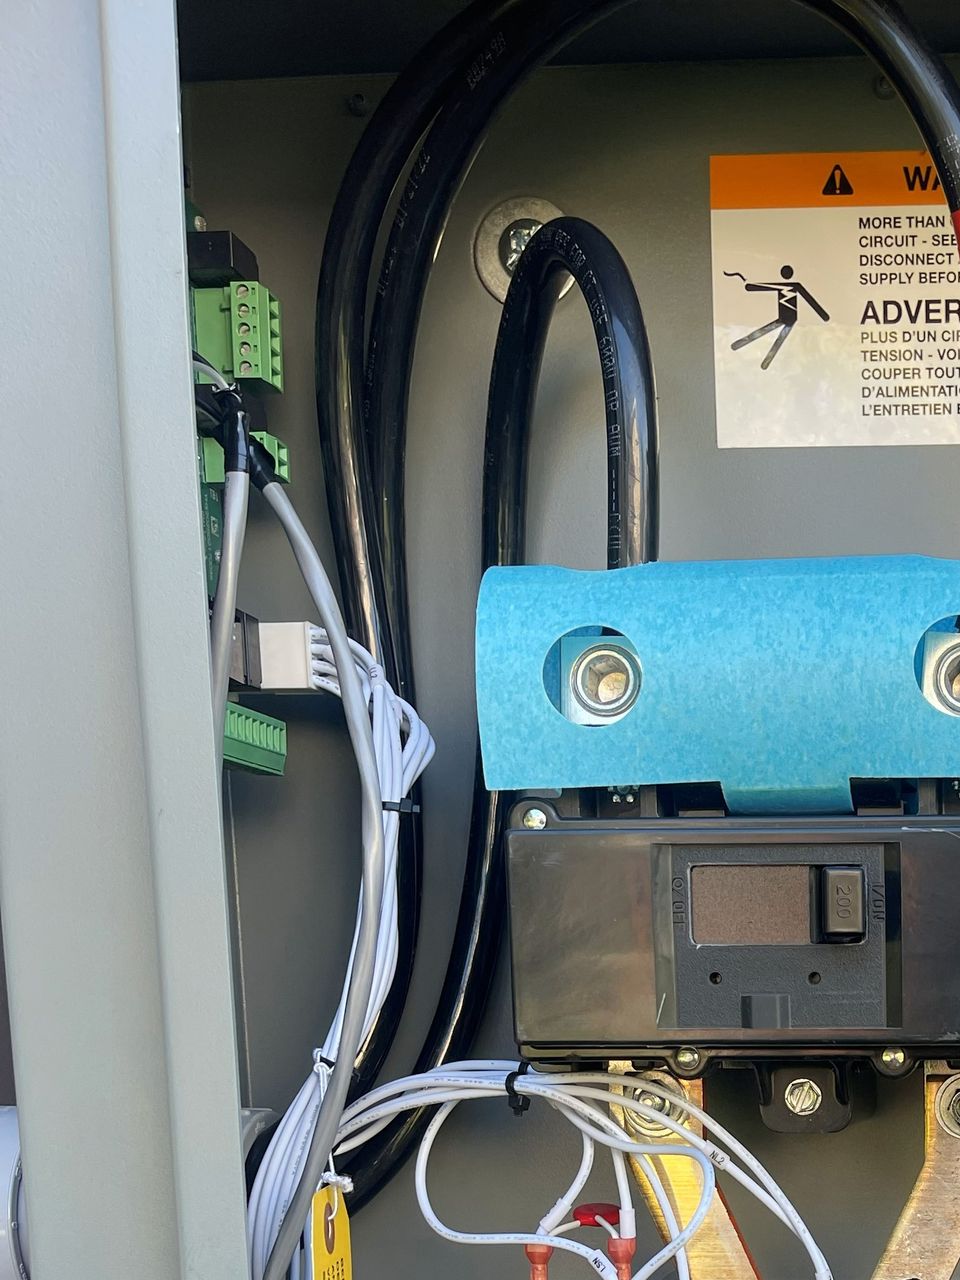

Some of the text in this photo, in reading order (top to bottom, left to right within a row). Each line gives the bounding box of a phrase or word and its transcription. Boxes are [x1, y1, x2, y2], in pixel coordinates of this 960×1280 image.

[858, 216, 945, 229] MORE THAN
[859, 235, 918, 248] CIRCUIT
[931, 234, 957, 246] SEE
[859, 253, 954, 266] DISCONNECT
[859, 272, 914, 285] SUPPLY
[861, 331, 898, 343] PLUS
[902, 330, 937, 343] D'UN
[860, 349, 923, 362] TENSION
[861, 368, 921, 380] COUPER
[862, 403, 952, 416] L'ENTRETIEN
[836, 885, 851, 919] 200
[710, 1150, 725, 1166] NL2
[592, 1257, 606, 1272] LSN
